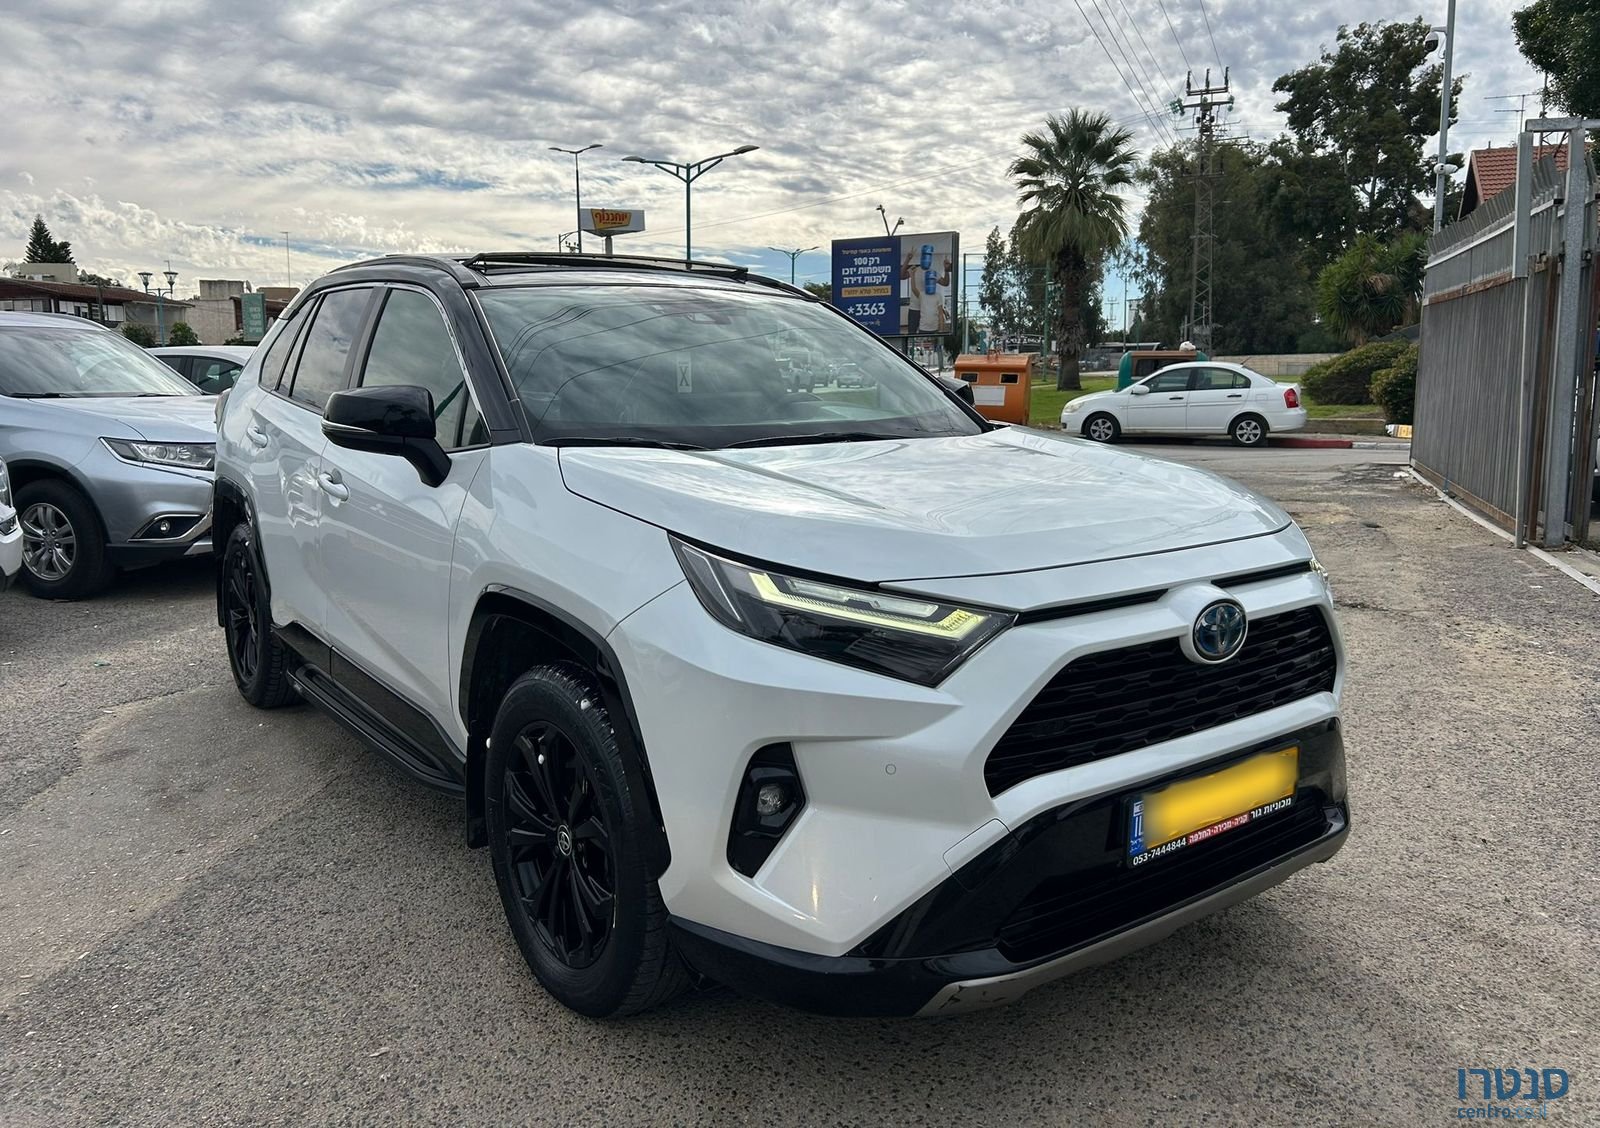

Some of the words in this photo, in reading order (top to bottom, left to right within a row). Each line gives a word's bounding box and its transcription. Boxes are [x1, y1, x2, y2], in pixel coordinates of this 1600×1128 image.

[853, 257, 868, 266] 100
[868, 257, 881, 266] רק
[841, 267, 857, 275] יזכו
[857, 265, 892, 275] משפחות
[843, 276, 862, 285] דירה
[863, 273, 888, 285] לקנות
[1263, 797, 1292, 815] מכוניות
[1250, 808, 1262, 819] גור
[1133, 837, 1187, 866] 053-7444844
